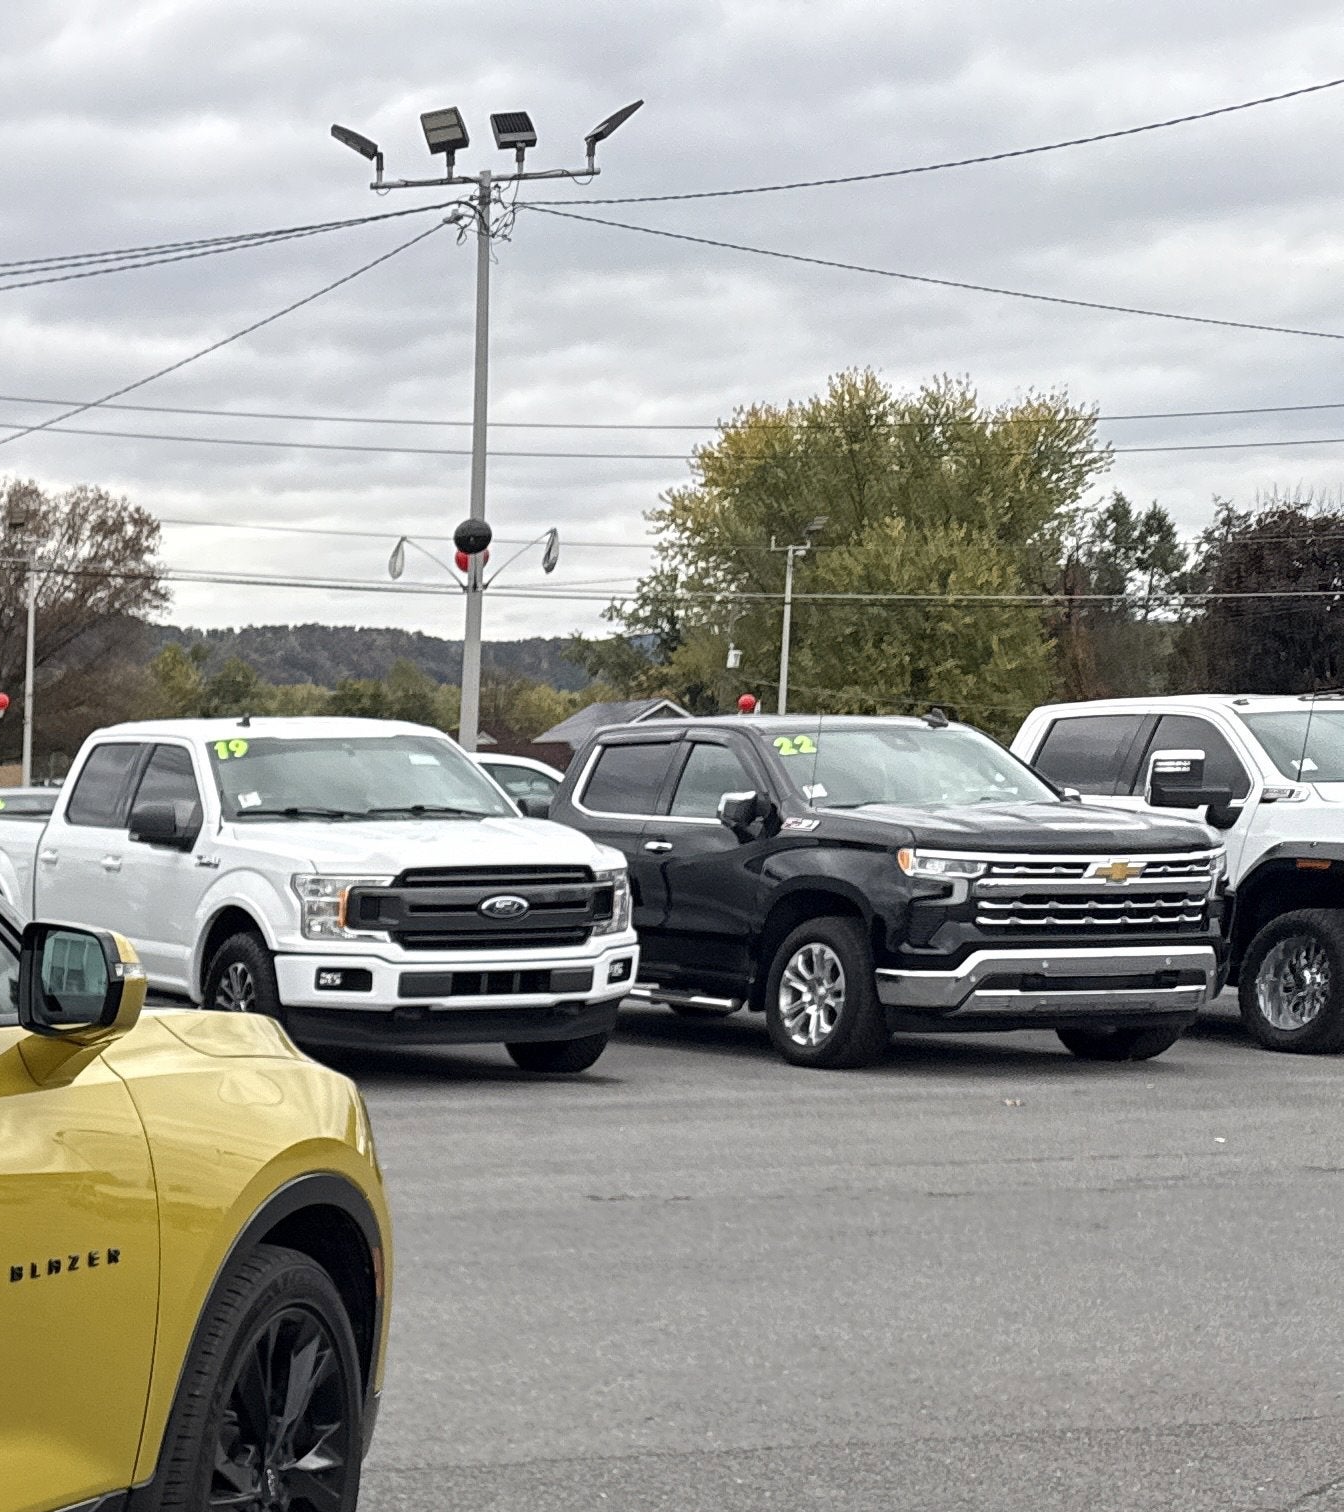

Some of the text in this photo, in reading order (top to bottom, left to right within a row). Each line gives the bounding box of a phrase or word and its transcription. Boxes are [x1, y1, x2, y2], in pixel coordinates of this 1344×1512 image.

[214, 740, 248, 760] 19
[773, 735, 817, 756] 22
[9, 1248, 120, 1283] BLAZER
